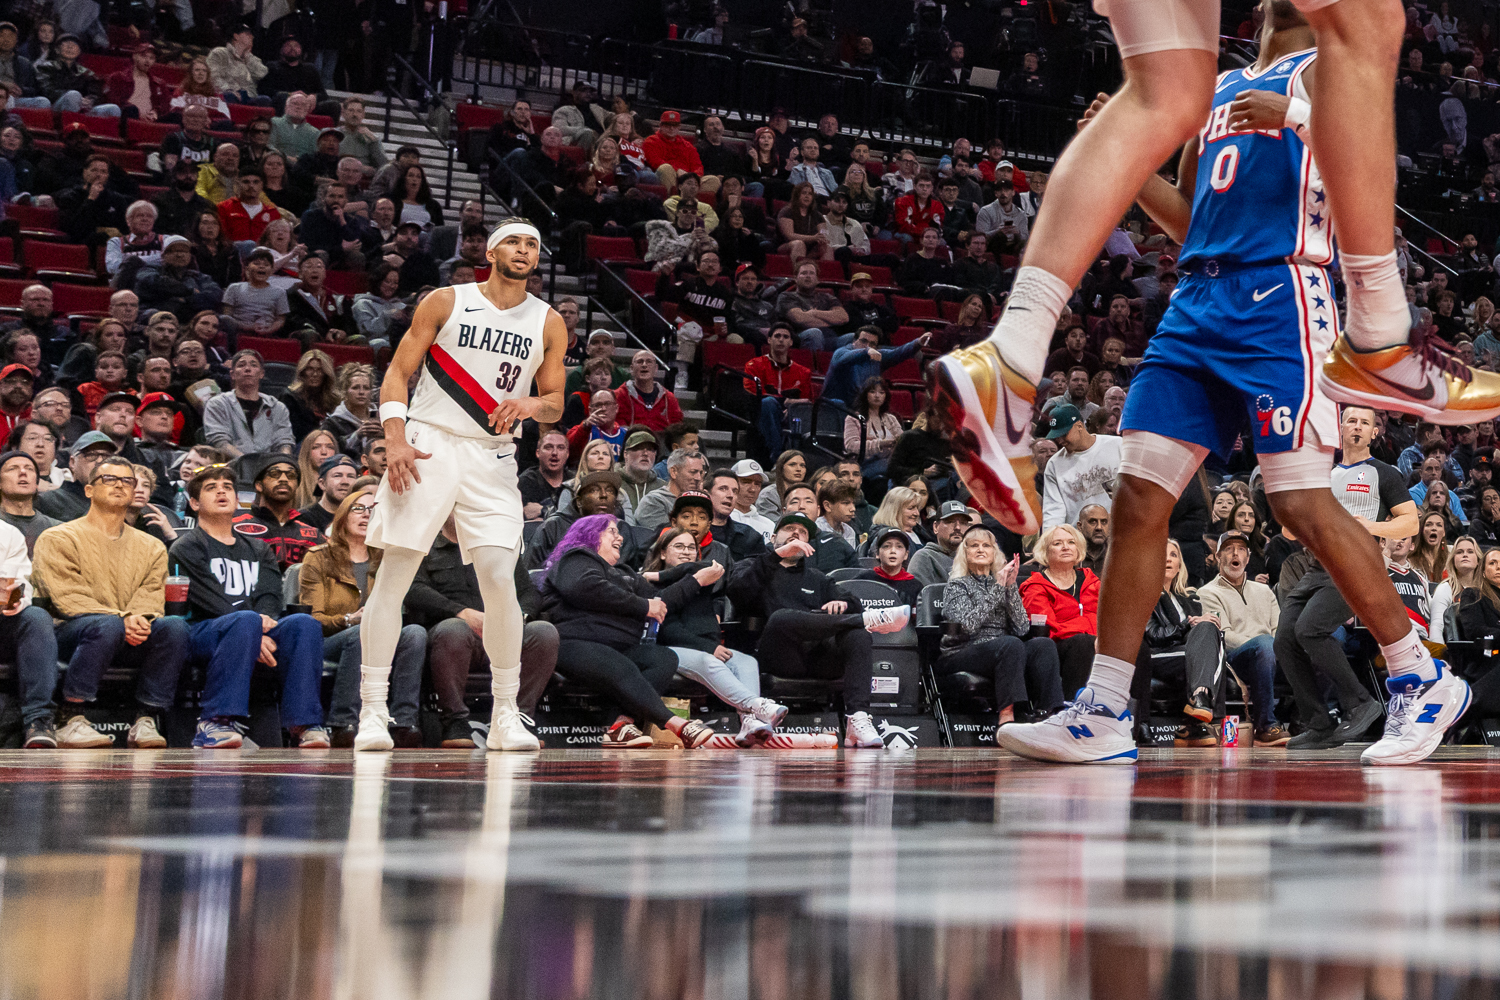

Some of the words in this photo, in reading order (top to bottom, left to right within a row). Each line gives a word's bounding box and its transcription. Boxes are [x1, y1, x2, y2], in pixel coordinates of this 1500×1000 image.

[1210, 144, 1241, 194] 0
[457, 323, 533, 360] BLAZERS
[495, 361, 522, 393] 33
[1256, 406, 1293, 436] 76
[1346, 485, 1370, 493] Emirates
[536, 725, 569, 735] SPIRIT
[791, 725, 840, 735] MOUNTAIN
[953, 723, 981, 732] SPIRIT
[1066, 723, 1095, 740] N
